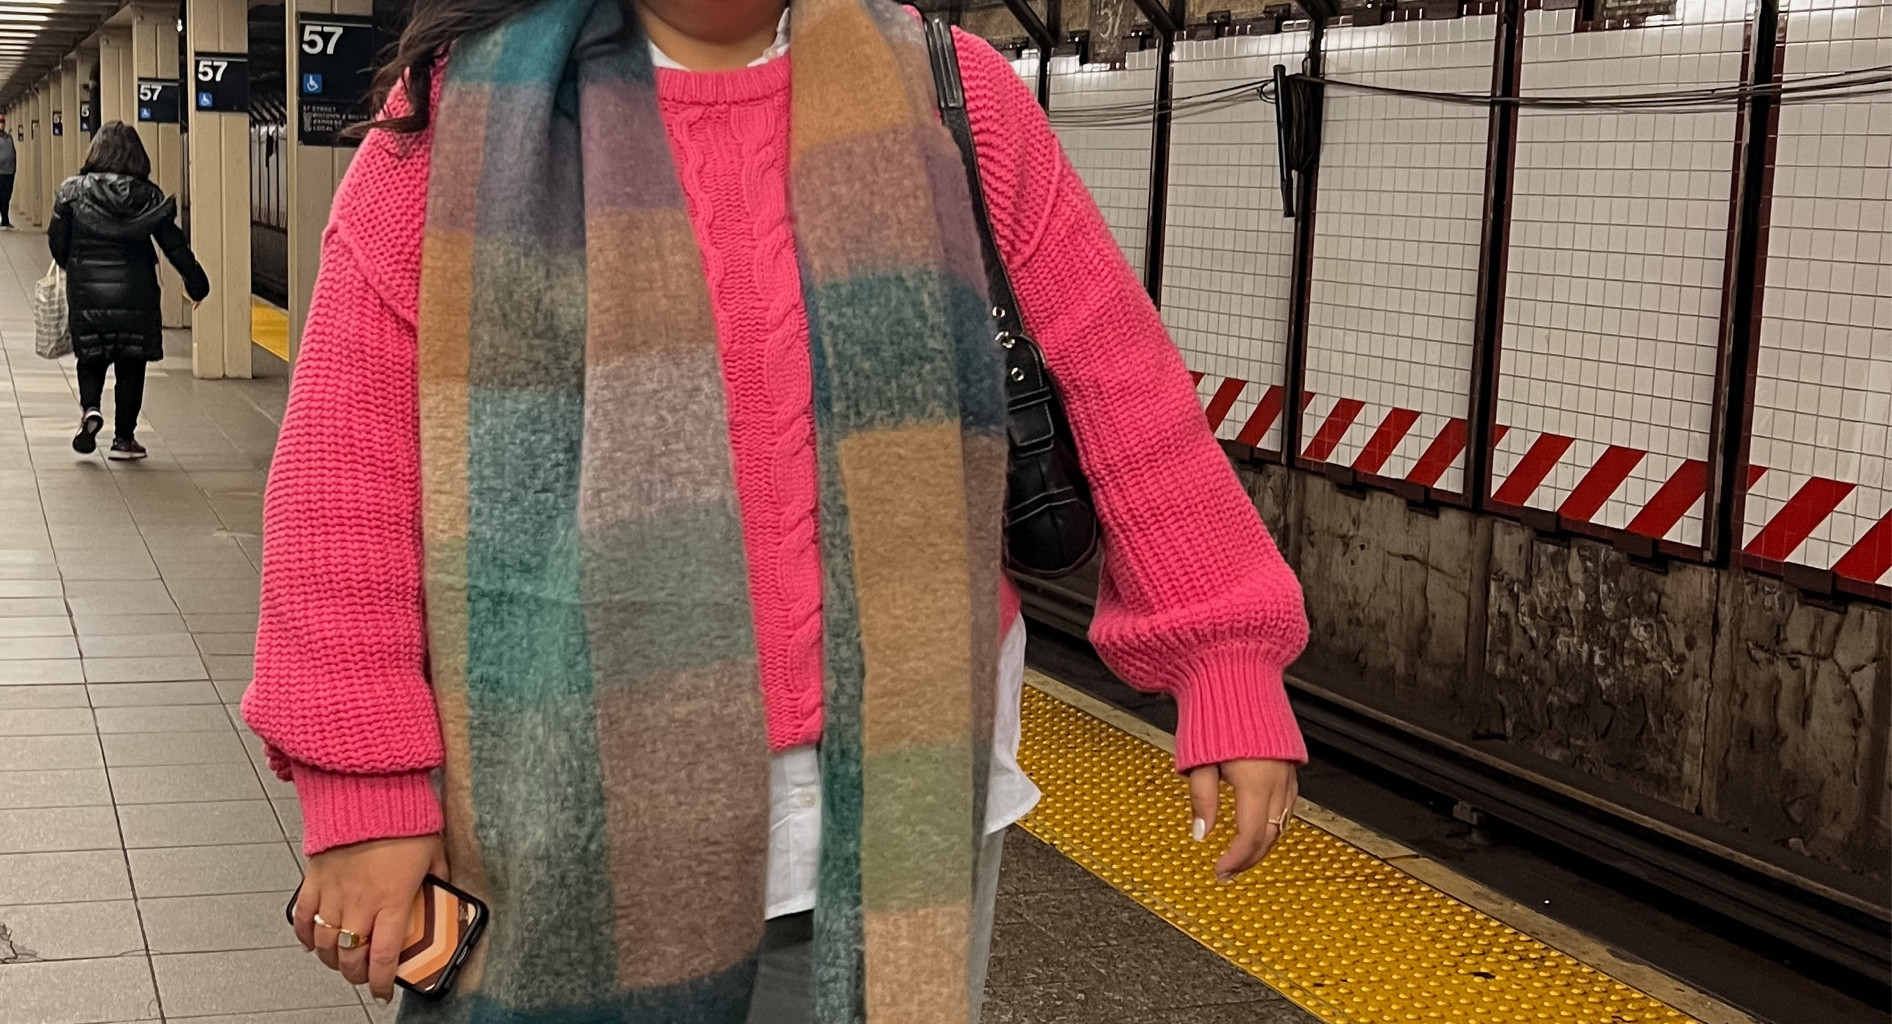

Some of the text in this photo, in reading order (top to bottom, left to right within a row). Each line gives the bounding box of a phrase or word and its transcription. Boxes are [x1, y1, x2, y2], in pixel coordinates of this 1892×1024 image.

[302, 24, 344, 55] 57
[198, 60, 228, 82] 57
[139, 85, 163, 101] 57
[81, 104, 90, 117] 5
